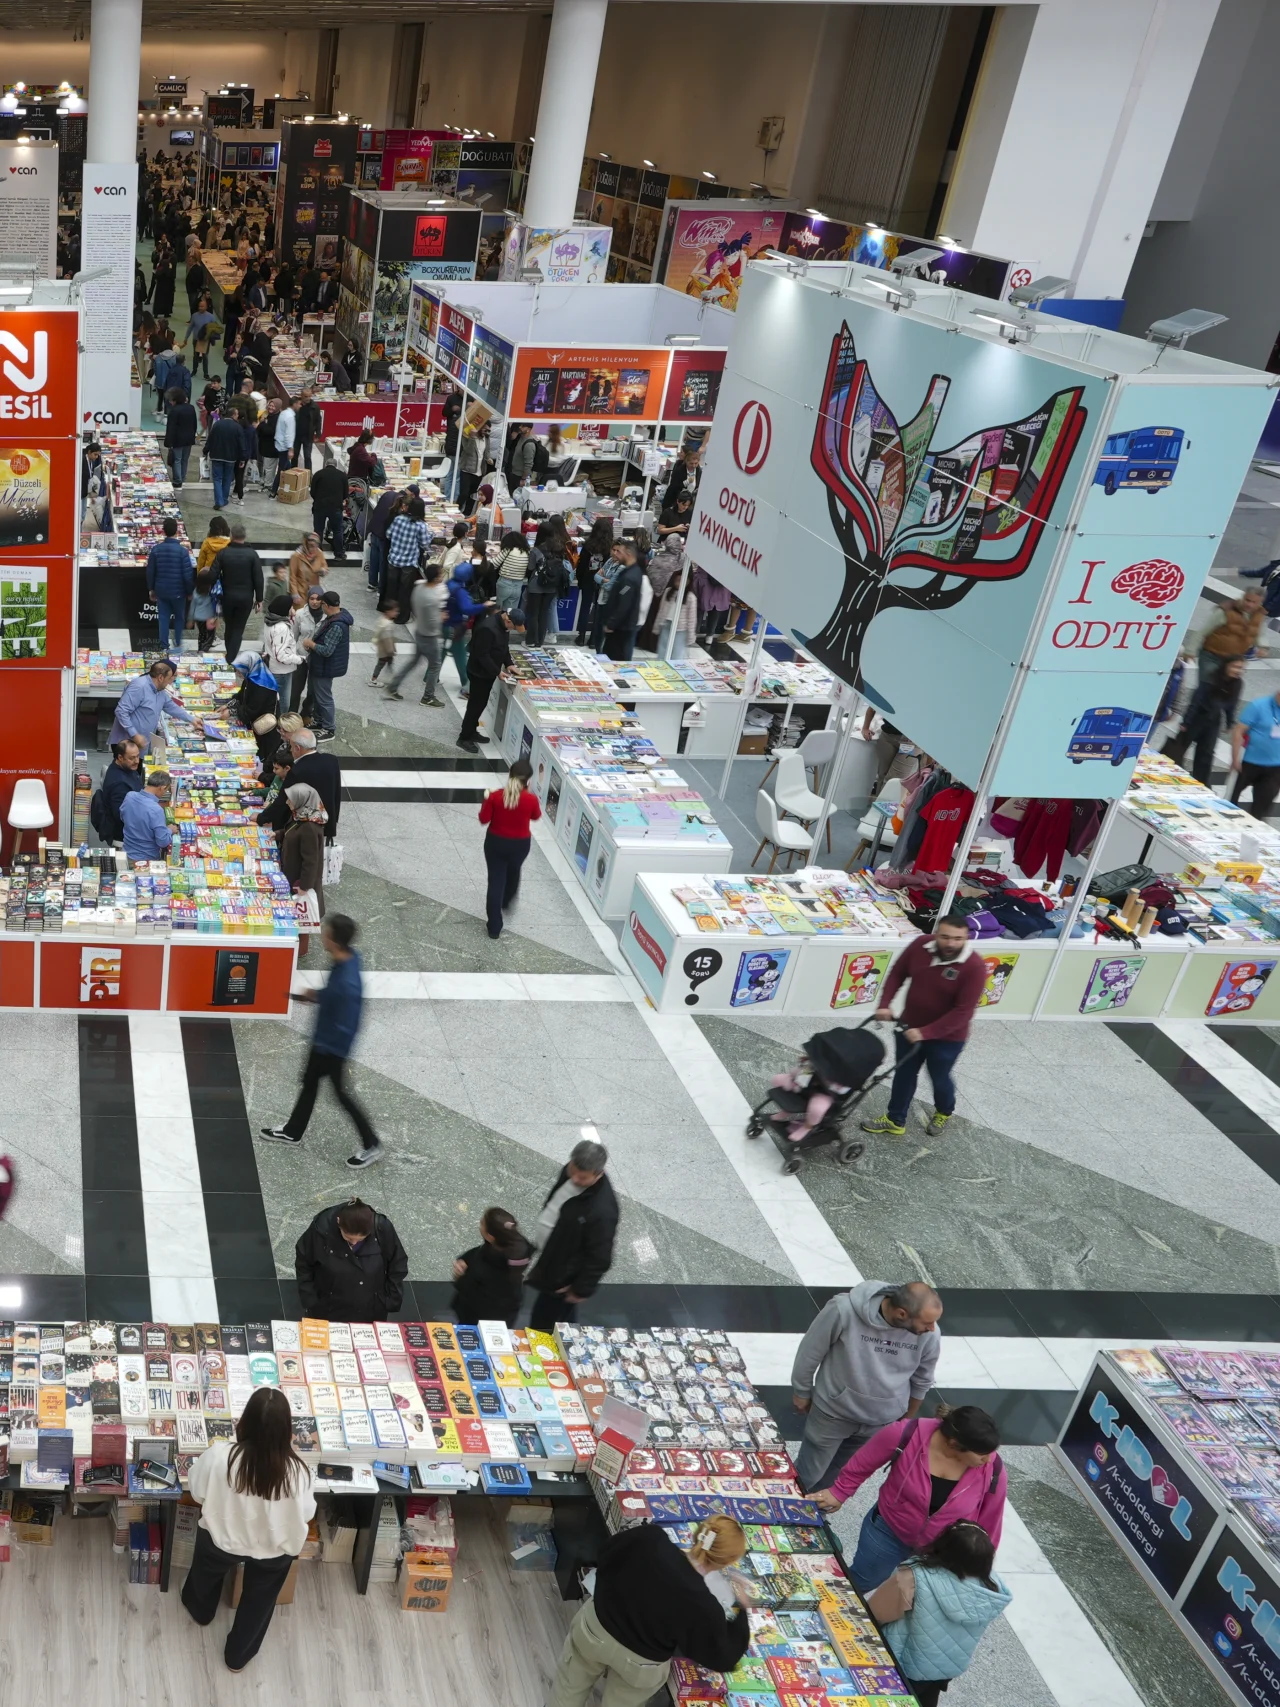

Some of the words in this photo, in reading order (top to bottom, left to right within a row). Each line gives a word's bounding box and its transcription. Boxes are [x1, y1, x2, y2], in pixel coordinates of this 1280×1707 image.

[17, 166, 38, 176] can
[102, 185, 127, 196] can
[548, 268, 580, 276] ÖTÜKEN
[449, 310, 466, 334] ALFA
[93, 411, 128, 426] can
[719, 486, 756, 527] ODTÜ
[699, 509, 762, 576] YAYINCILIK
[1068, 560, 1106, 604] I
[1051, 615, 1176, 651] ODTÜ
[693, 956, 712, 969] 15
[690, 969, 710, 978] SORU
[860, 1334, 884, 1346] TOMMY
[892, 1340, 919, 1352] HILFIGER
[1106, 1465, 1164, 1539] /k-idoldergi
[1100, 1483, 1158, 1558] /k-idoldergi
